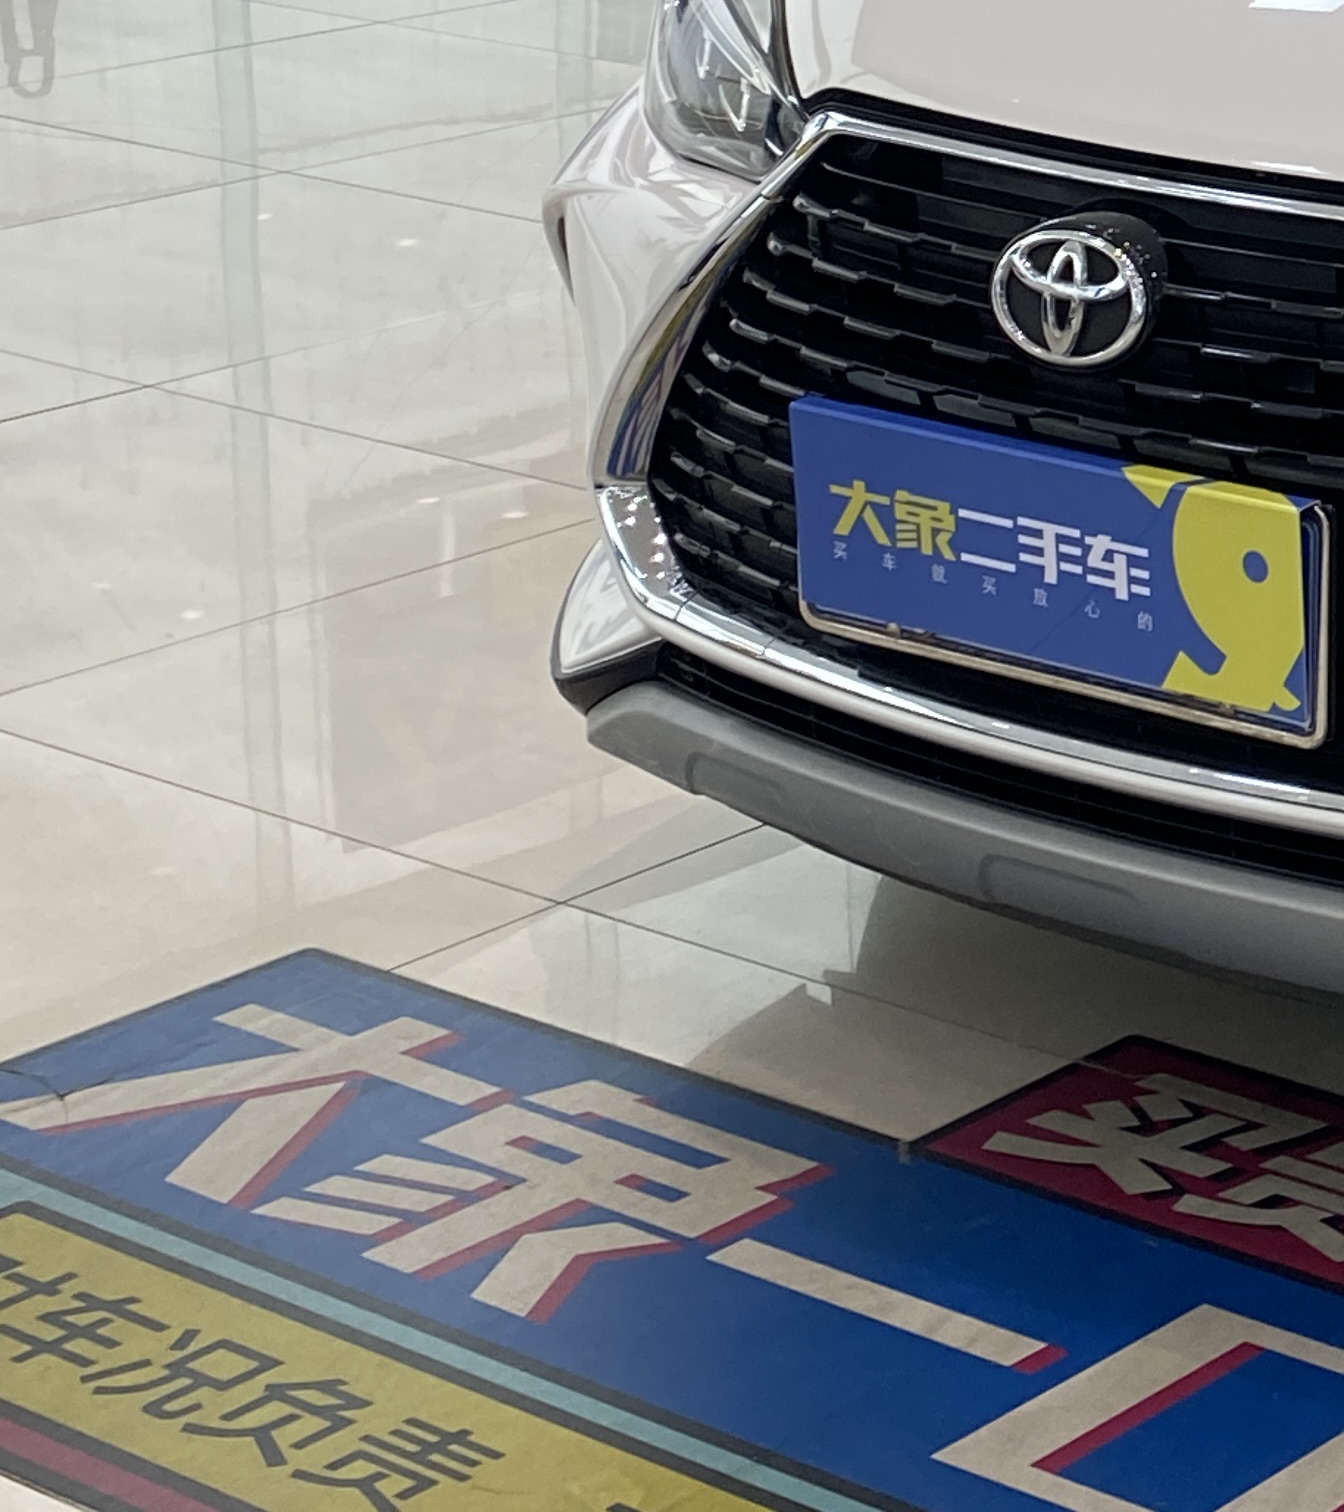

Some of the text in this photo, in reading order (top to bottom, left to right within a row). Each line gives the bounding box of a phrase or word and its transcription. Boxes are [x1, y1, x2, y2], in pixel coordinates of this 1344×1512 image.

[829, 479, 1152, 602] 大象二手车
